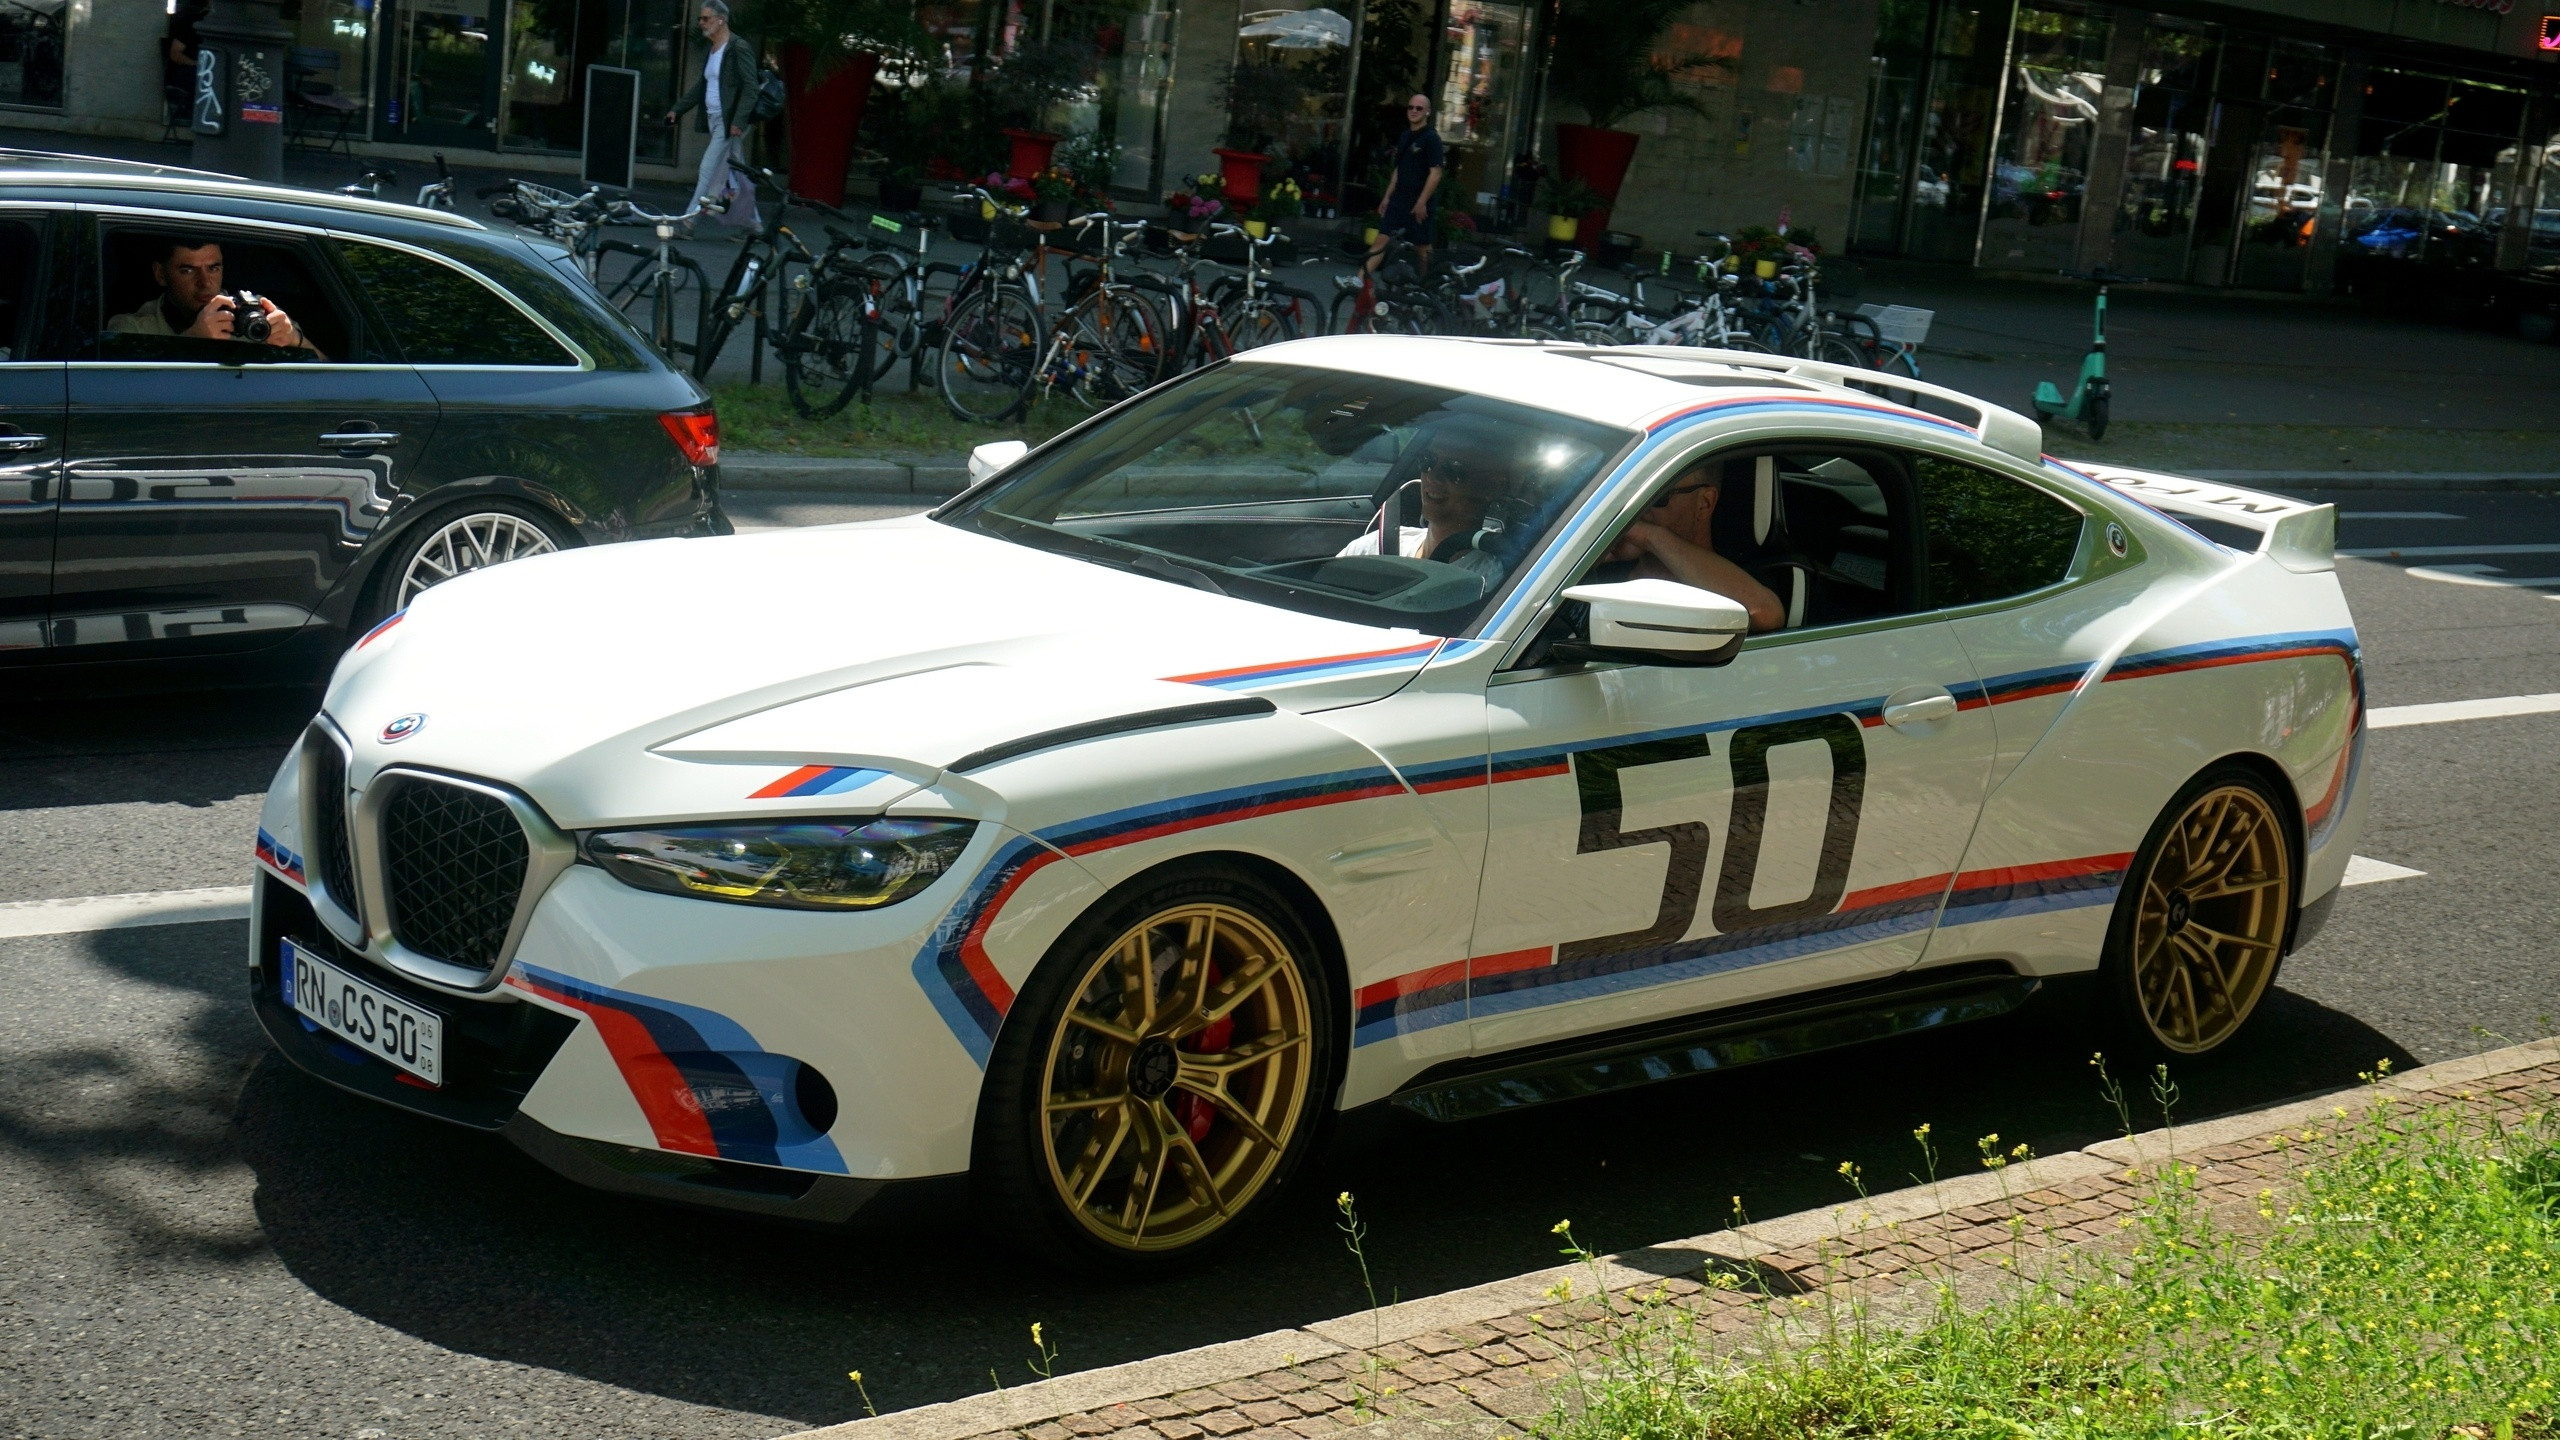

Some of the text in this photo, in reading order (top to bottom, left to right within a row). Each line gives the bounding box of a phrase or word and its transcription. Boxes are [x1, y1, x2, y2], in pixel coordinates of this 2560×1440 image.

[2204, 496, 2292, 514] M
[1557, 712, 1867, 965] 50
[286, 979, 293, 994] D
[296, 957, 417, 1064] RN CS 50
[420, 1022, 433, 1039] 06
[420, 1056, 433, 1073] 08
